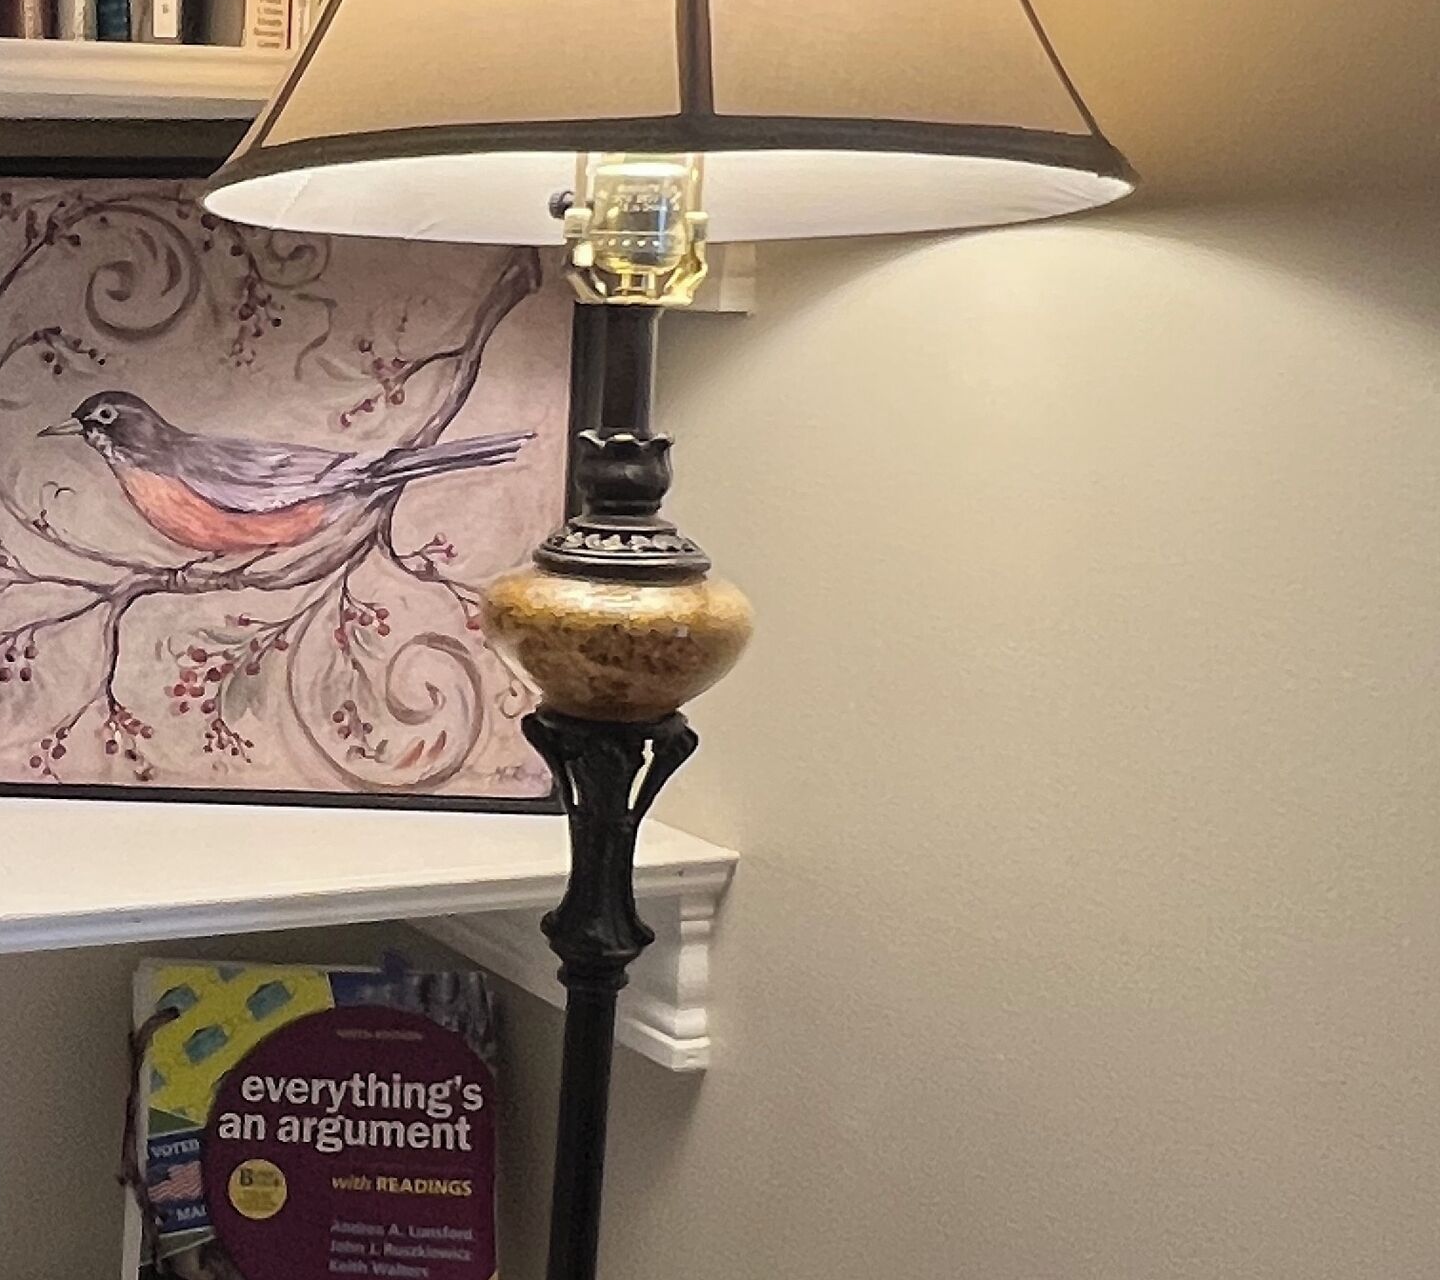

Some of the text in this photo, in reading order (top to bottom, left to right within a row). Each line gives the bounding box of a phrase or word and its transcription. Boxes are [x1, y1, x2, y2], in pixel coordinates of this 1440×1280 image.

[241, 1072, 484, 1119] everything's
[217, 1111, 473, 1153] an argument
[150, 1139, 200, 1158] VOTED
[332, 1174, 473, 1197] with READINGS
